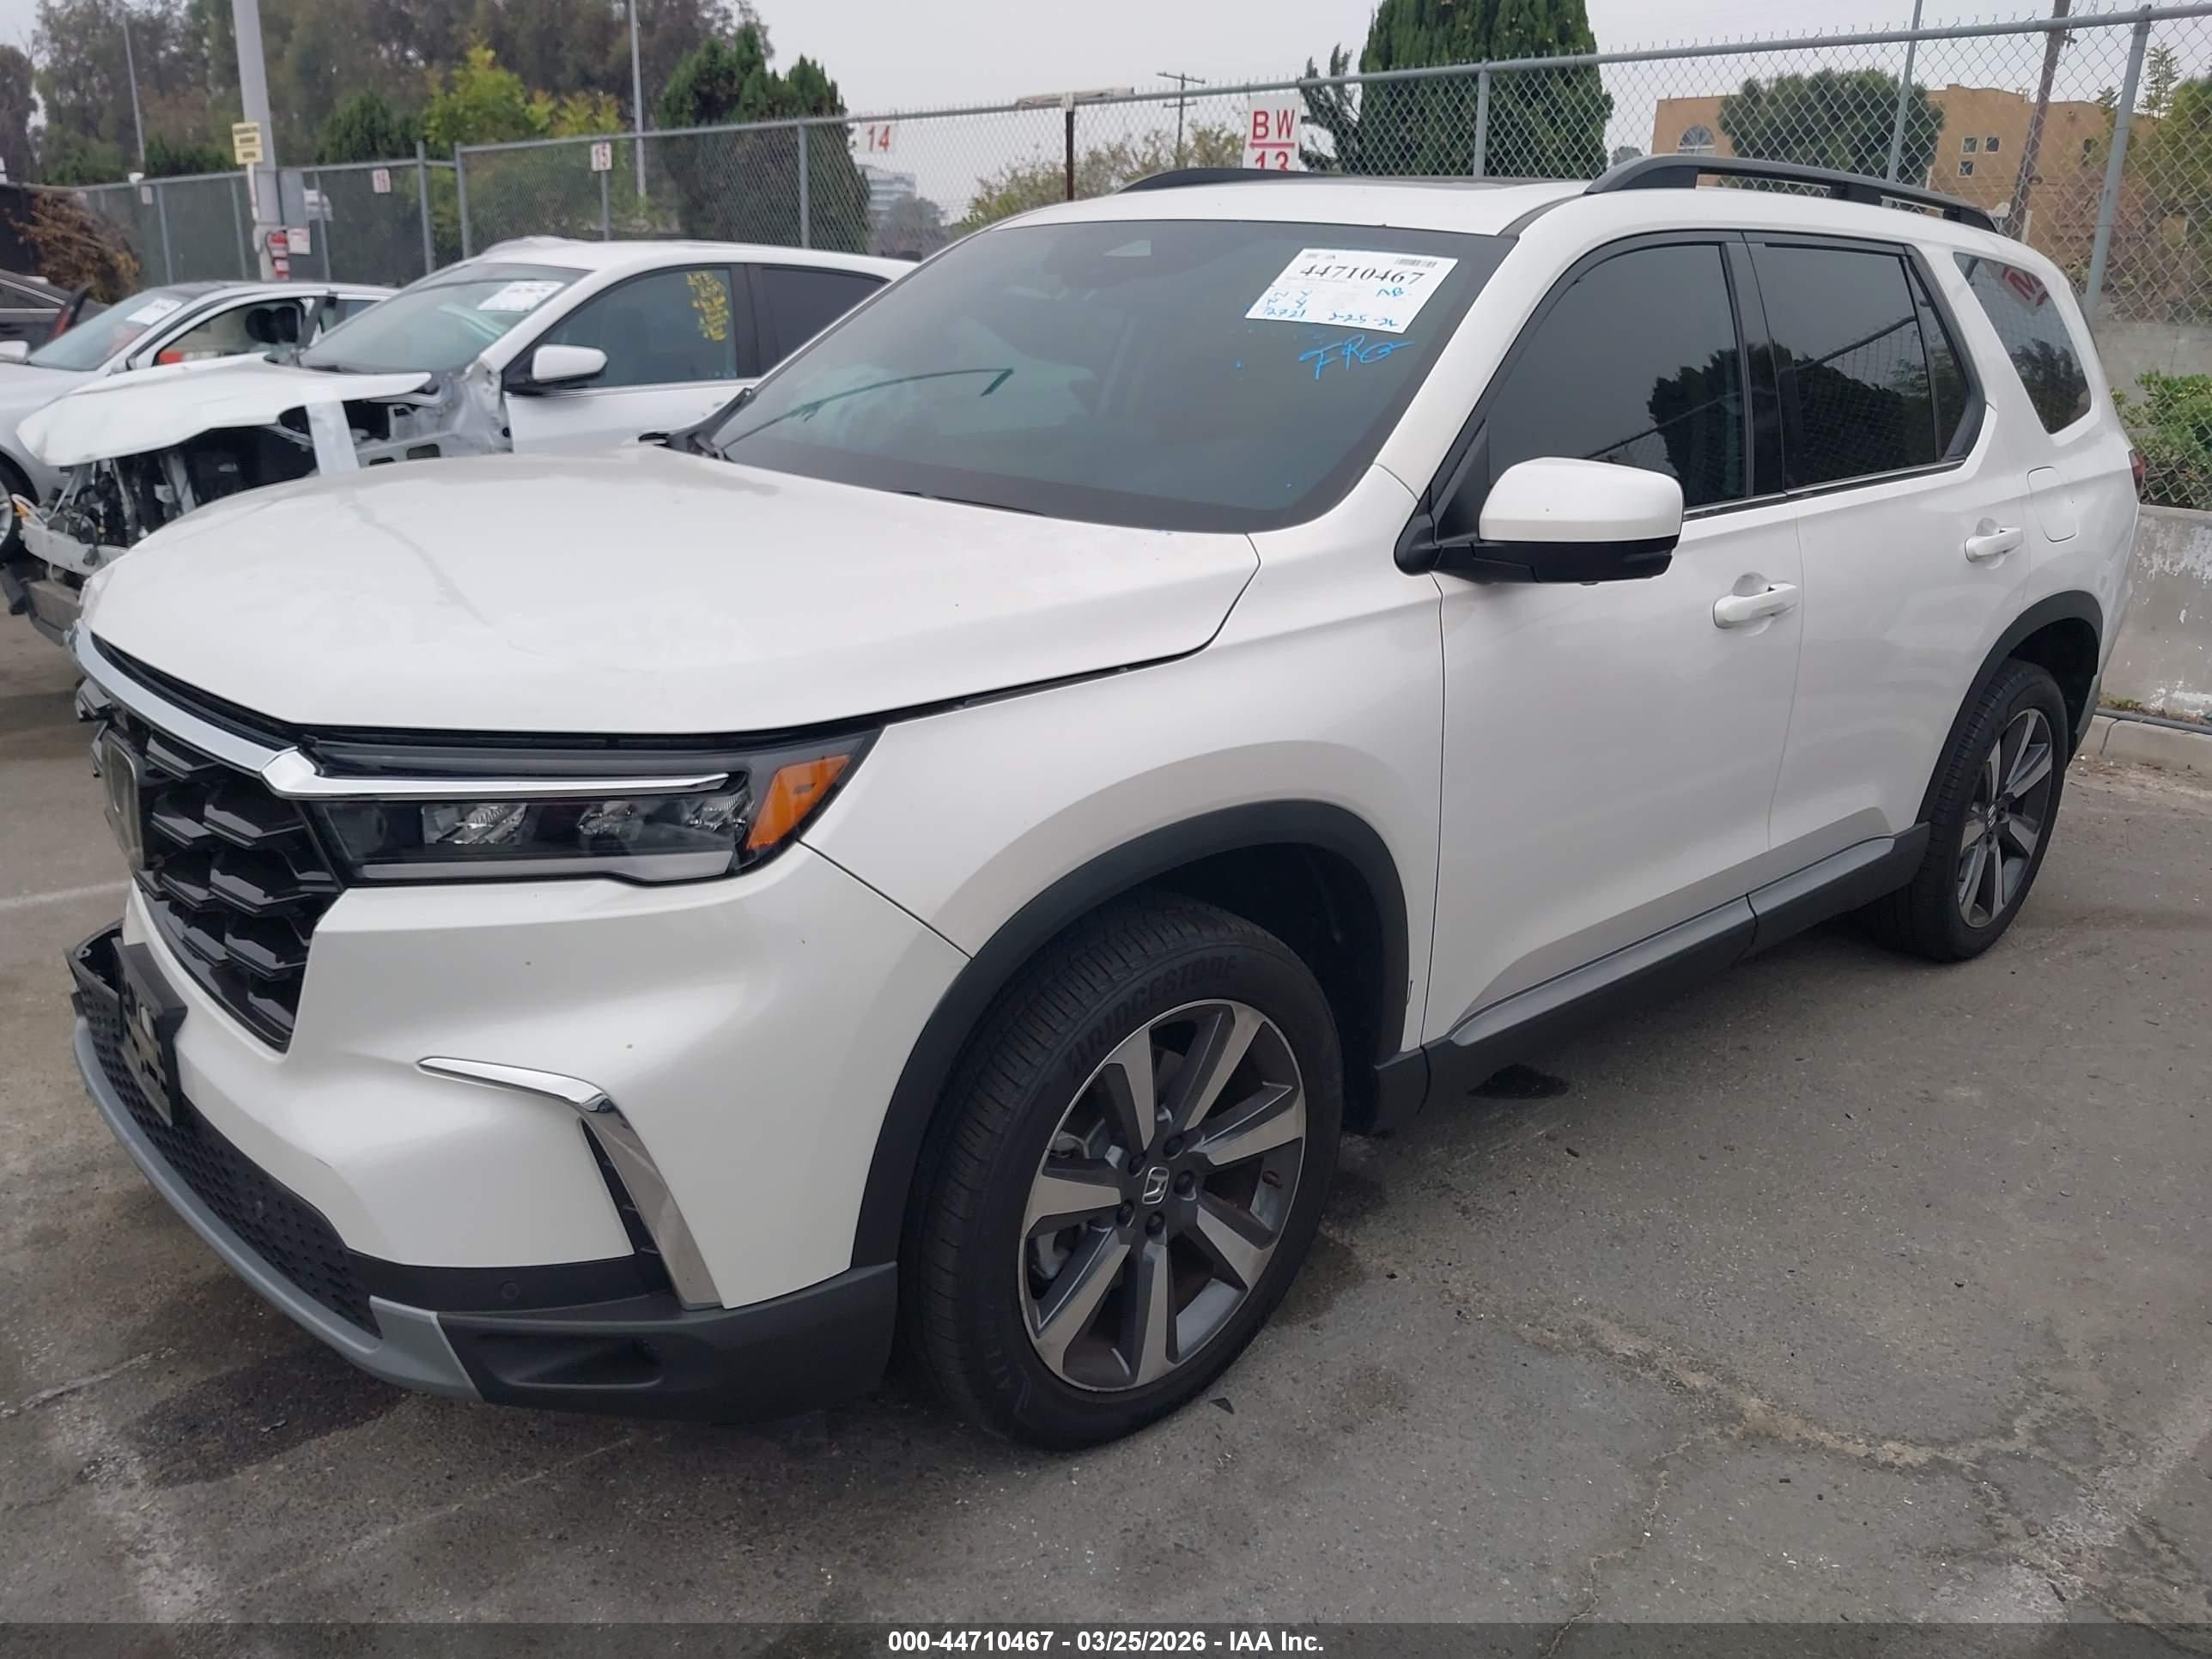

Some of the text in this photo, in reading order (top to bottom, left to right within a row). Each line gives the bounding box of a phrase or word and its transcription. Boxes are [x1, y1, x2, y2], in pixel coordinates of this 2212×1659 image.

[1252, 109, 1295, 140] BW
[868, 125, 890, 152] 14
[1299, 264, 1425, 285] 44710467
